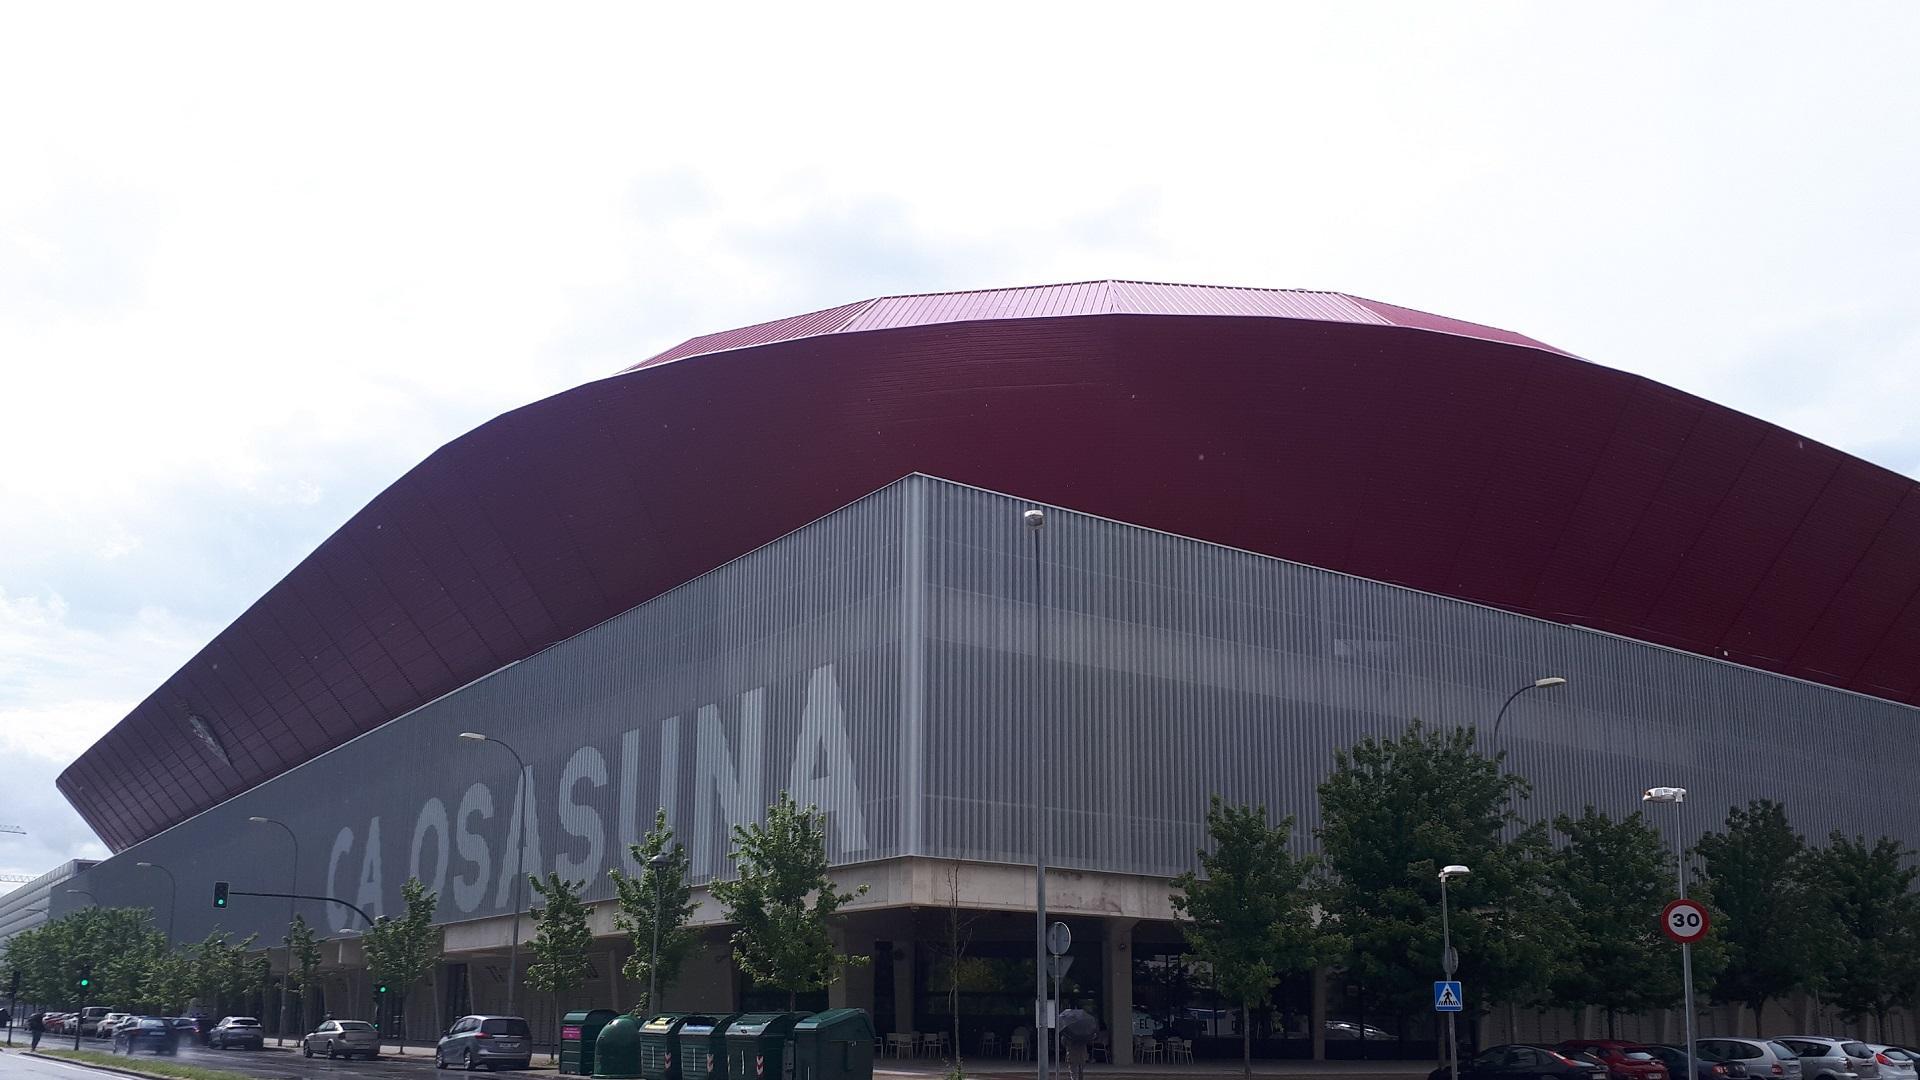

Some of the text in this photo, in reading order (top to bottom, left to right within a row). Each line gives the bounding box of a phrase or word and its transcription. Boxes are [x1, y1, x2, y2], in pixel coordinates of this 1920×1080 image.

[326, 662, 870, 933] CA OSASUNA
[1672, 913, 1700, 928] 30
